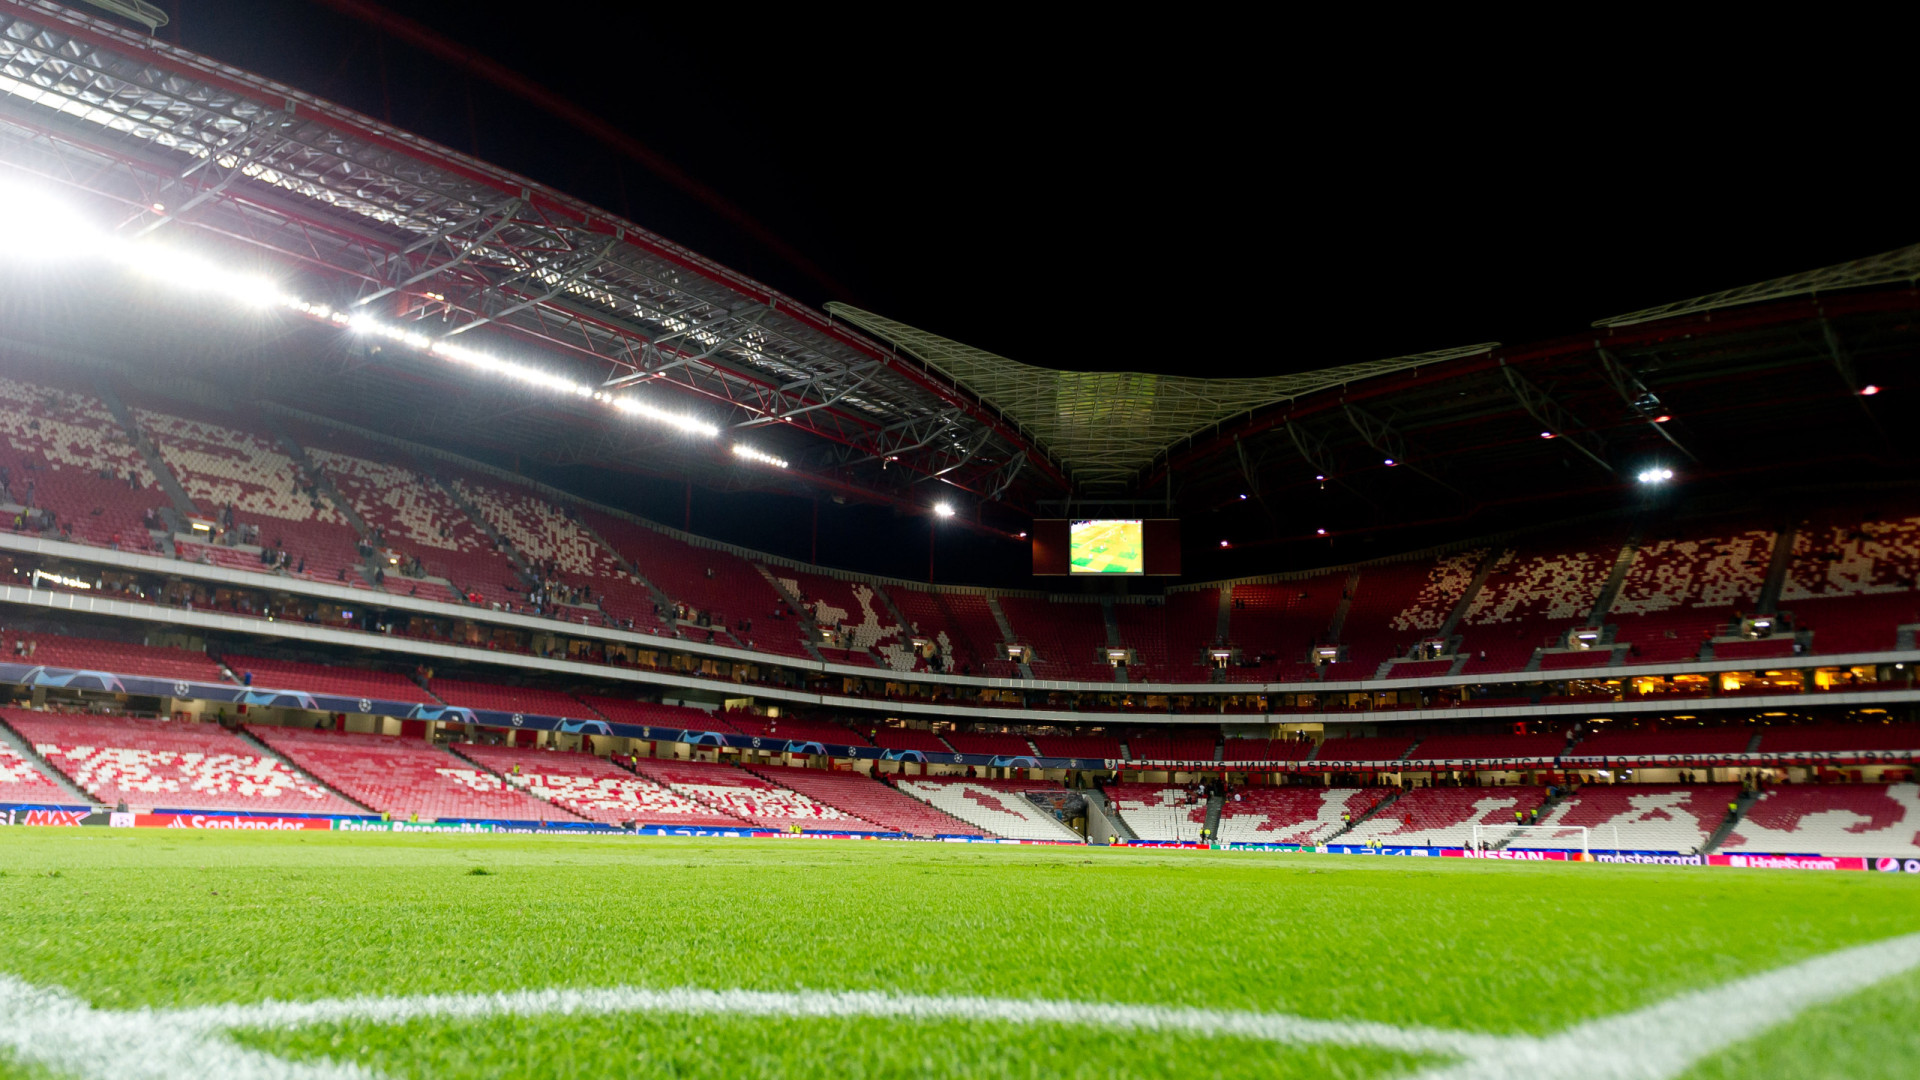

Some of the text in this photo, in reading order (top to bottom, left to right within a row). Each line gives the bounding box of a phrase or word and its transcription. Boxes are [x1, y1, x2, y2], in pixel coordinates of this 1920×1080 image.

[1125, 759, 1278, 771] E PLURIBUS UNUM
[1307, 757, 1545, 772] SPORT LISBOA E BENFICA
[1617, 756, 1628, 766] O
[1637, 754, 1750, 767] GLORIOSO
[1760, 752, 1840, 767] DESDE
[24, 809, 91, 826] MAX
[191, 815, 304, 830] Santander
[1463, 850, 1544, 860] NISSAN
[1597, 852, 1701, 866] mastercard
[1750, 857, 1836, 870] Hotels.com
